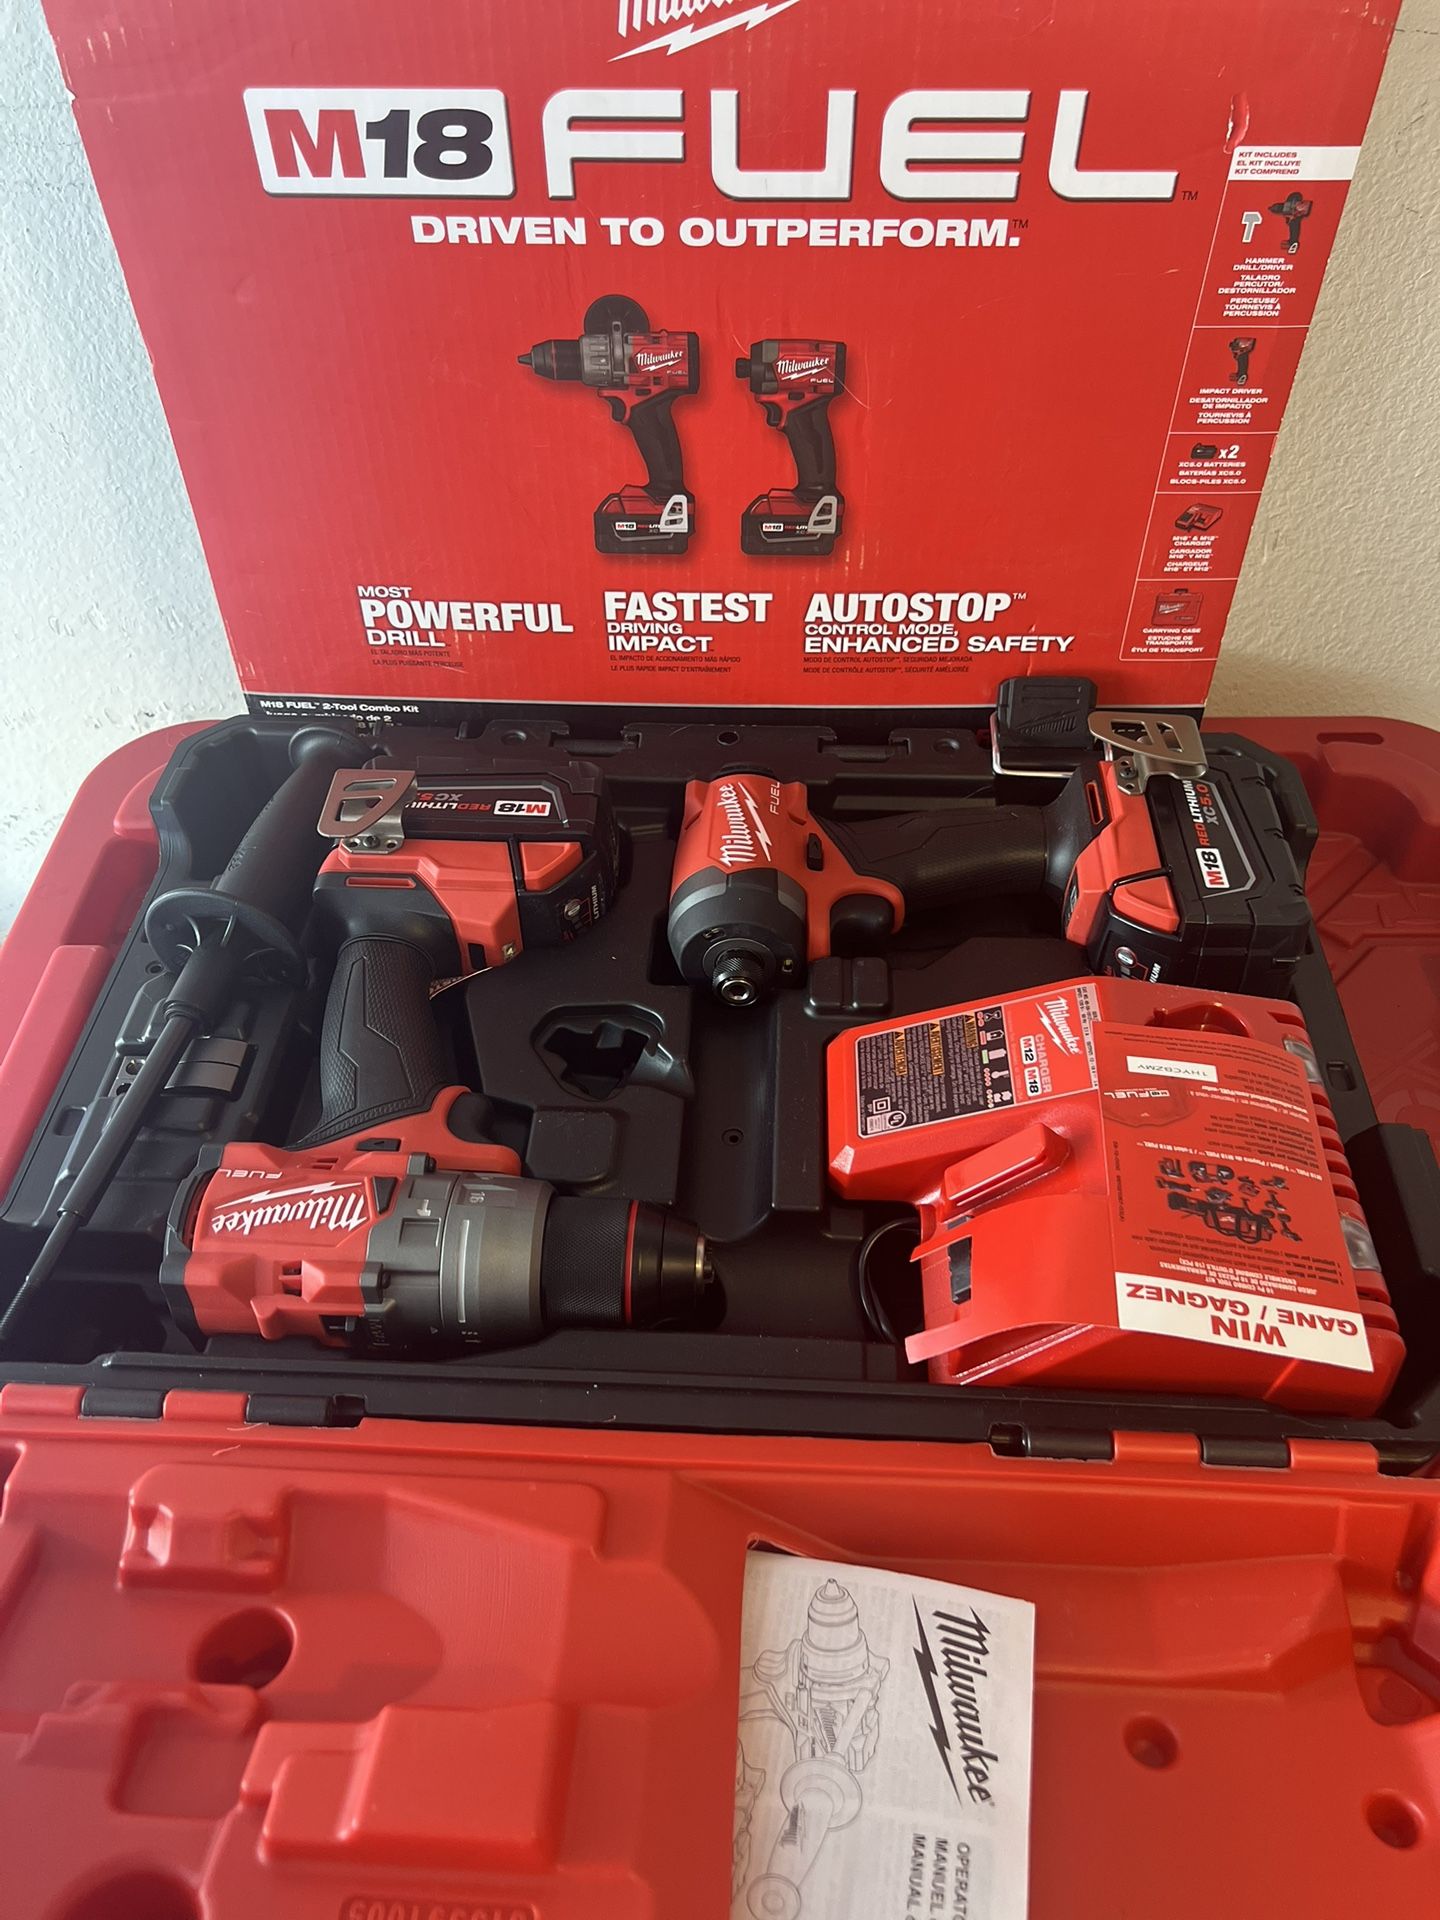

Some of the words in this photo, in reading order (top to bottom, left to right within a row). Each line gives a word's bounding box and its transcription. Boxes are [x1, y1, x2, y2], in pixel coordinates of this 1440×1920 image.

[261, 107, 494, 181] M18
[411, 215, 587, 245] DRIVEN
[601, 218, 665, 246] TO
[776, 357, 830, 375] Milwaukee
[1218, 445, 1240, 459] x2
[357, 585, 412, 598] MOST
[604, 591, 773, 622] FASTEST
[360, 598, 574, 633] POWERFUL
[607, 622, 683, 634] DRIVING
[804, 623, 893, 636] CONTROL
[898, 623, 959, 637] MODE,
[366, 630, 446, 647] DRILL
[608, 635, 713, 652] IMPACT
[804, 636, 960, 653] ENHANCED
[967, 635, 1075, 652] SAFETY
[260, 700, 284, 708] M18
[322, 703, 357, 712] 2-Tool
[358, 704, 401, 713] Combo
[403, 704, 420, 714] Kit
[498, 802, 547, 814] M18
[769, 781, 781, 816] FUEL
[1182, 780, 1210, 847] REDLITHIUM
[716, 782, 758, 867] Milwaukee
[1201, 850, 1225, 886] M18
[1021, 1038, 1034, 1062] M12
[1033, 1033, 1053, 1094] CHARGER
[1026, 1069, 1040, 1096] M18
[1104, 1090, 1151, 1100] FUEL
[219, 1169, 283, 1180] FUEL
[211, 1192, 368, 1235] Milwaukee
[1126, 1282, 1251, 1317] GAGNEZ
[1211, 1315, 1287, 1348] WIN
[1277, 1307, 1359, 1337] GANE
[907, 1833, 926, 1912] MANUAL
[930, 1838, 949, 1913] MANUEL
